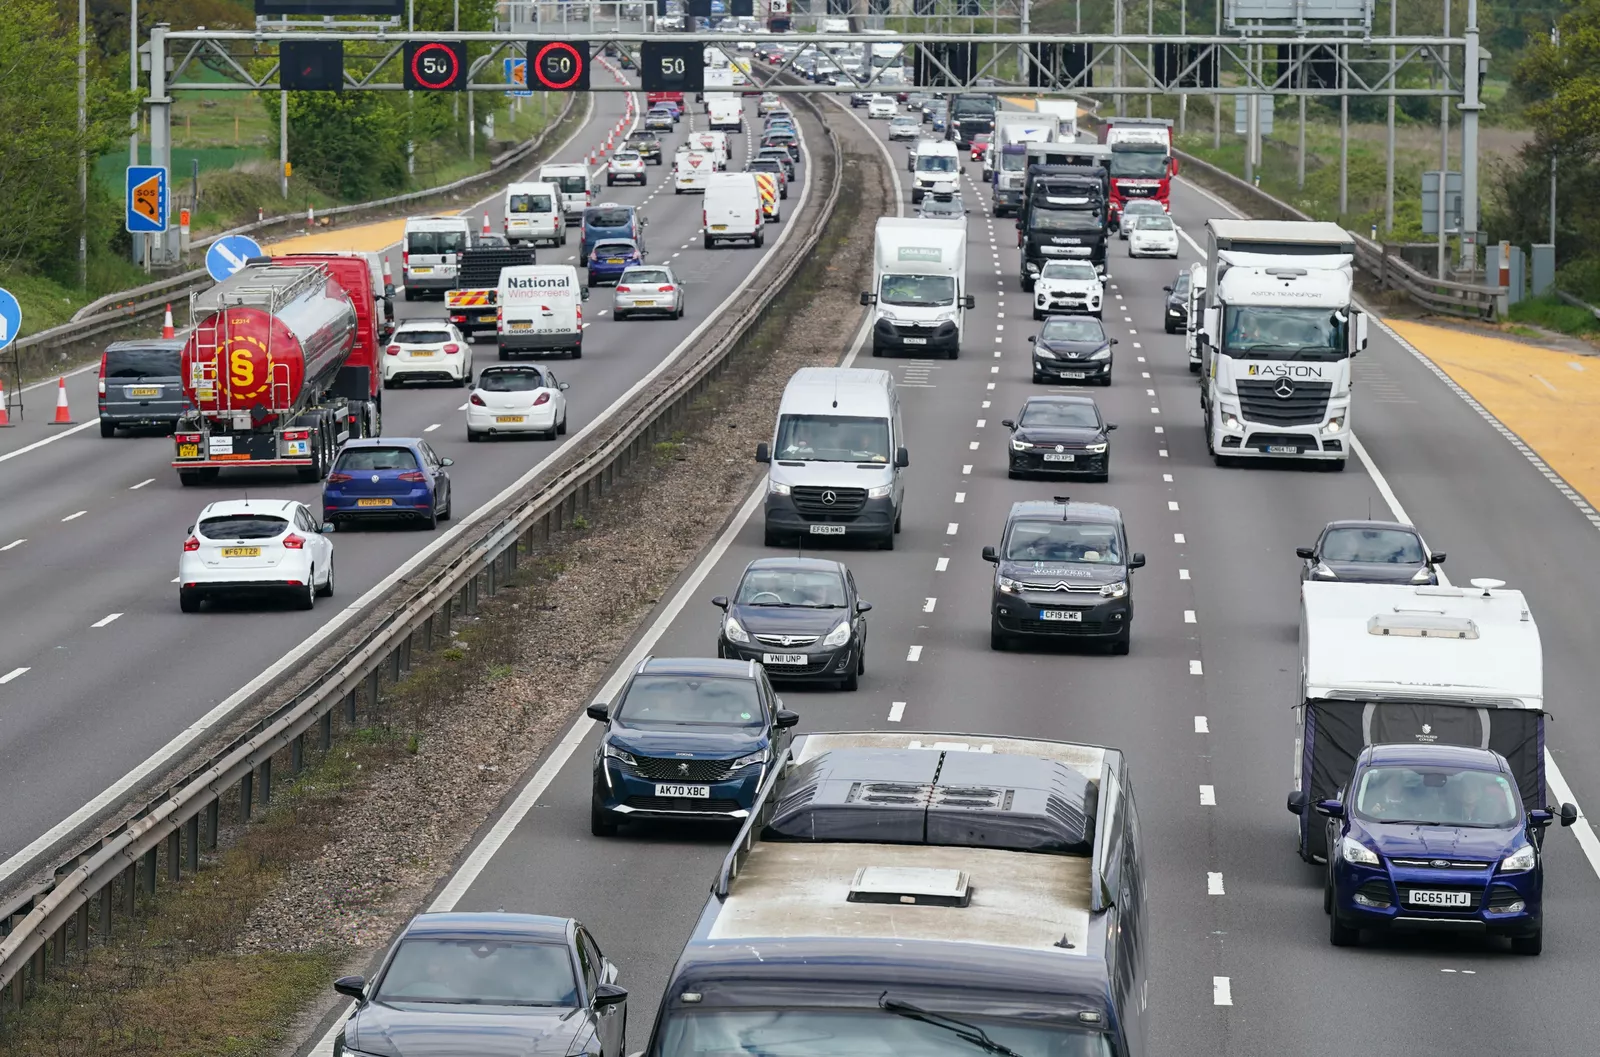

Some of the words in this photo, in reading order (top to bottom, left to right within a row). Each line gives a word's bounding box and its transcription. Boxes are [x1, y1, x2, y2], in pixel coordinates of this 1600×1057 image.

[424, 57, 447, 74] 50
[547, 57, 571, 74] 50
[661, 58, 685, 74] 50
[137, 189, 155, 197] SOS
[508, 276, 570, 288] National
[508, 290, 570, 298] Windscreens
[1261, 364, 1322, 377] ASTON
[812, 525, 829, 533] EF69
[225, 548, 243, 556] WF67
[785, 655, 801, 663] UNP
[659, 785, 684, 796] AK70
[686, 787, 706, 797] XBC
[1414, 892, 1443, 903] GC65
[1445, 893, 1467, 904] HTJ
